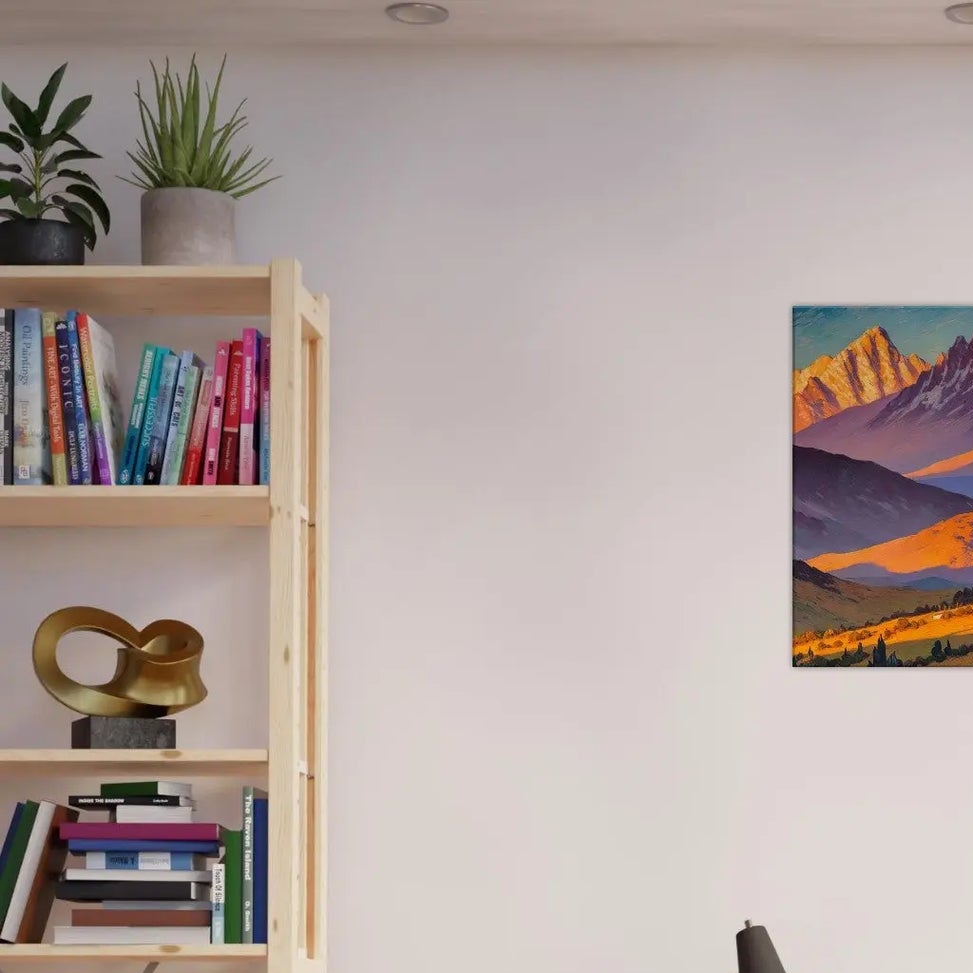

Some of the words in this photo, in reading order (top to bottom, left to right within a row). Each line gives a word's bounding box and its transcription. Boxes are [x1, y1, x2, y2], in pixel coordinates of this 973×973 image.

[22, 325, 33, 340] Oil
[18, 342, 32, 385] Paintings
[48, 365, 57, 379] ART
[59, 344, 74, 408] ICONIC
[80, 328, 92, 374] Watercolor
[86, 375, 98, 409] Portraits
[230, 363, 241, 397] Parenting
[244, 795, 252, 814] The
[244, 850, 252, 881] Island
